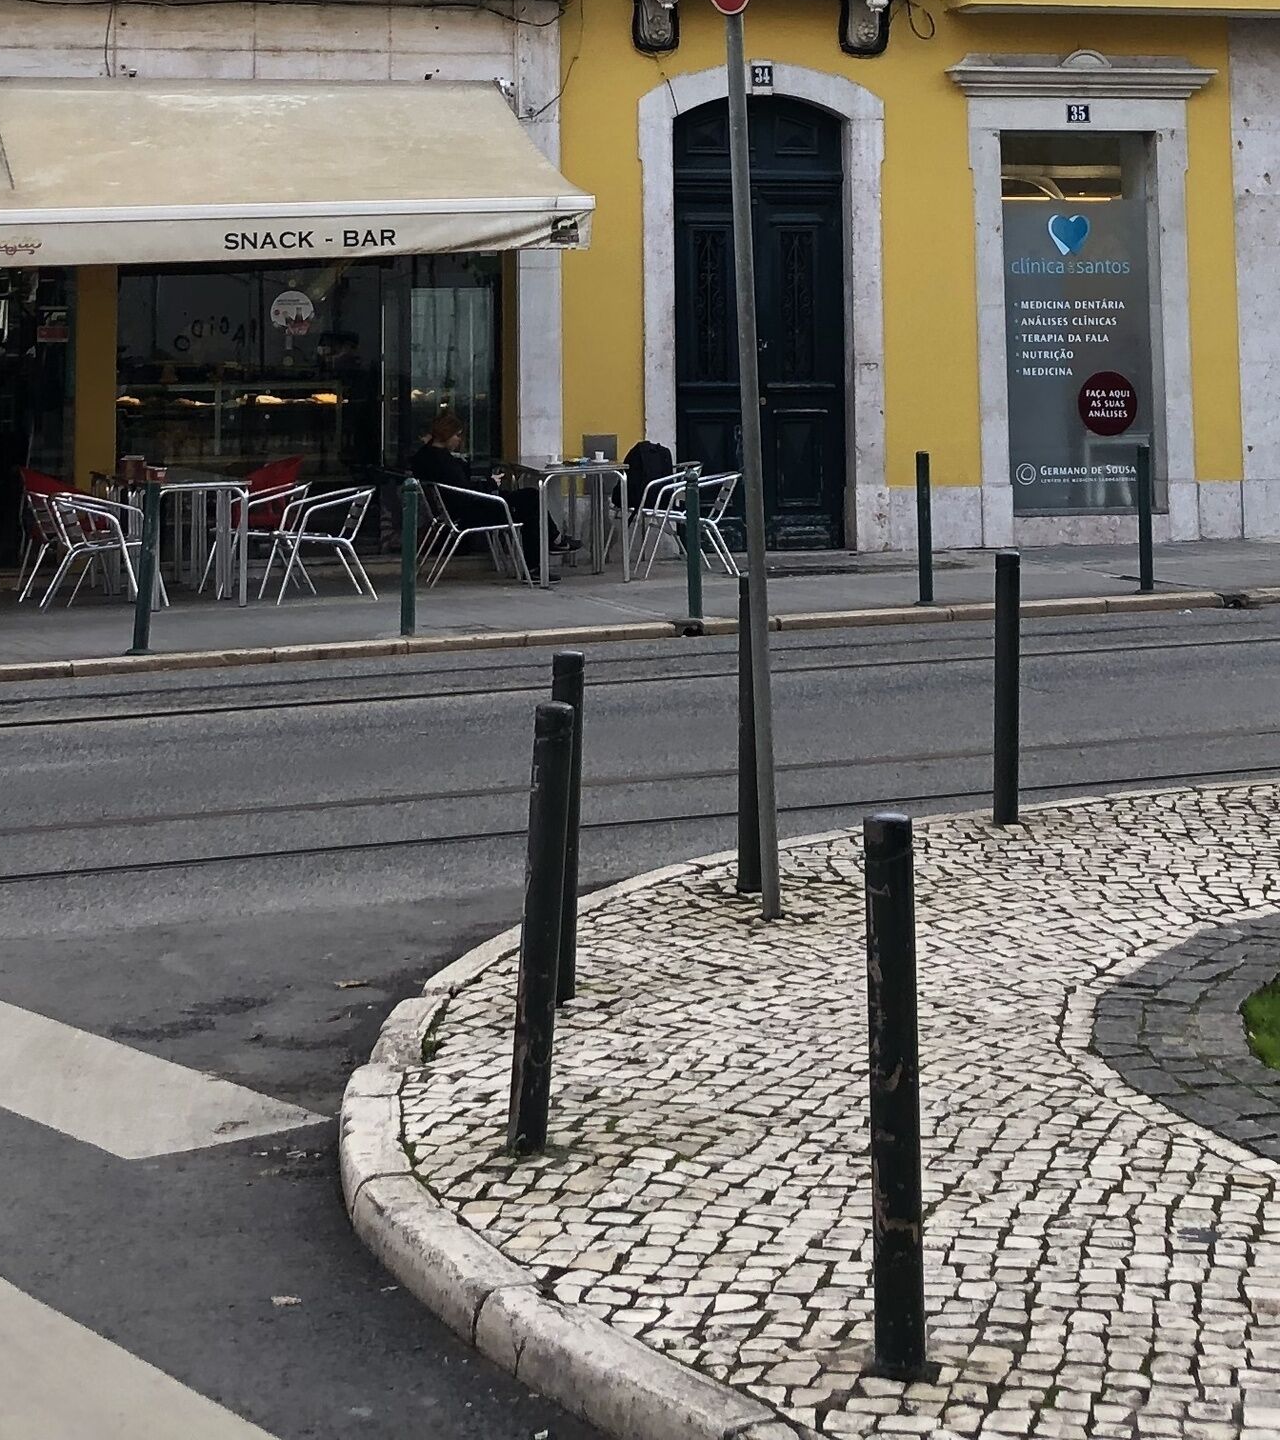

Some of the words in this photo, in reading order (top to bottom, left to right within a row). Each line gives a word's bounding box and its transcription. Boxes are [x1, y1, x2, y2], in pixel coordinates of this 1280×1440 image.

[754, 67, 771, 84] 34
[1070, 105, 1086, 121] 35
[223, 231, 315, 250] SNACK
[343, 229, 397, 248] BAR
[1011, 257, 1065, 274] clínica
[1076, 259, 1130, 274] santos
[1021, 300, 1071, 310] MEDICINA
[1074, 298, 1125, 310] DENTÁRIA
[1021, 315, 1068, 326] ANÁLISES
[1072, 315, 1117, 326] CLÍNICAS
[1022, 333, 1064, 343] TERAPIA
[1068, 333, 1082, 343] DA
[1085, 333, 1109, 343] FALA
[1022, 348, 1074, 361] NUTRIÇÃO
[1022, 367, 1073, 376] MEDICINA
[1086, 389, 1106, 400] FAÇA
[1109, 389, 1130, 399] AQUI
[1091, 400, 1101, 408] AS
[1104, 400, 1125, 408] SUAS
[1088, 409, 1128, 418] ANÁLISES
[1040, 465, 1088, 476] GERMANO
[1091, 466, 1102, 475] DE
[1106, 464, 1137, 475] SOUSA
